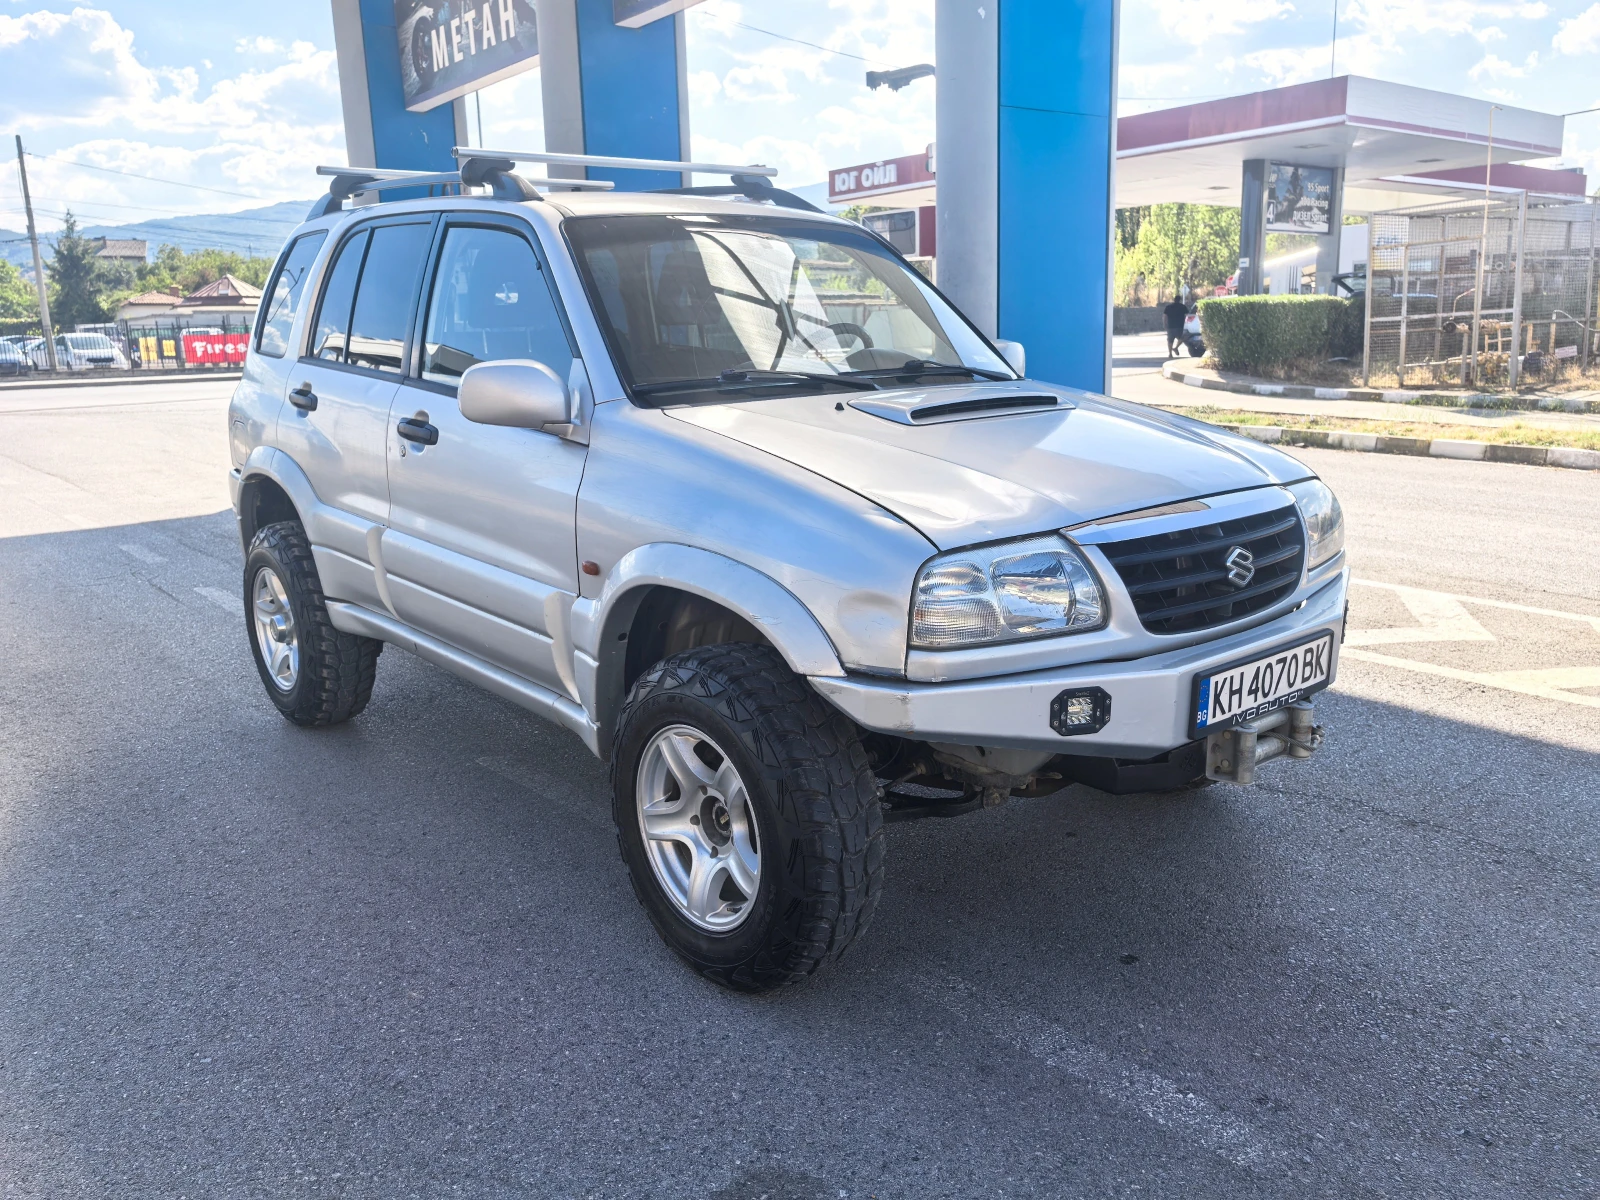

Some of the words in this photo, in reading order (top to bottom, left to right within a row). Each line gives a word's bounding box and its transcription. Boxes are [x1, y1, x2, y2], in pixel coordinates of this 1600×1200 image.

[431, 0, 516, 72] МЕТАН
[834, 171, 858, 192] ЮГ
[861, 161, 897, 187] ОЙЛ
[1314, 183, 1329, 194] Sport
[1266, 202, 1274, 222] 4
[1310, 197, 1329, 210] Racing
[1311, 212, 1328, 223] Sprint
[1212, 671, 1245, 719] KH
[1247, 653, 1299, 703] 4070
[1301, 641, 1328, 684] BK
[1259, 691, 1298, 714] AUTO
[1197, 709, 1208, 723] BG
